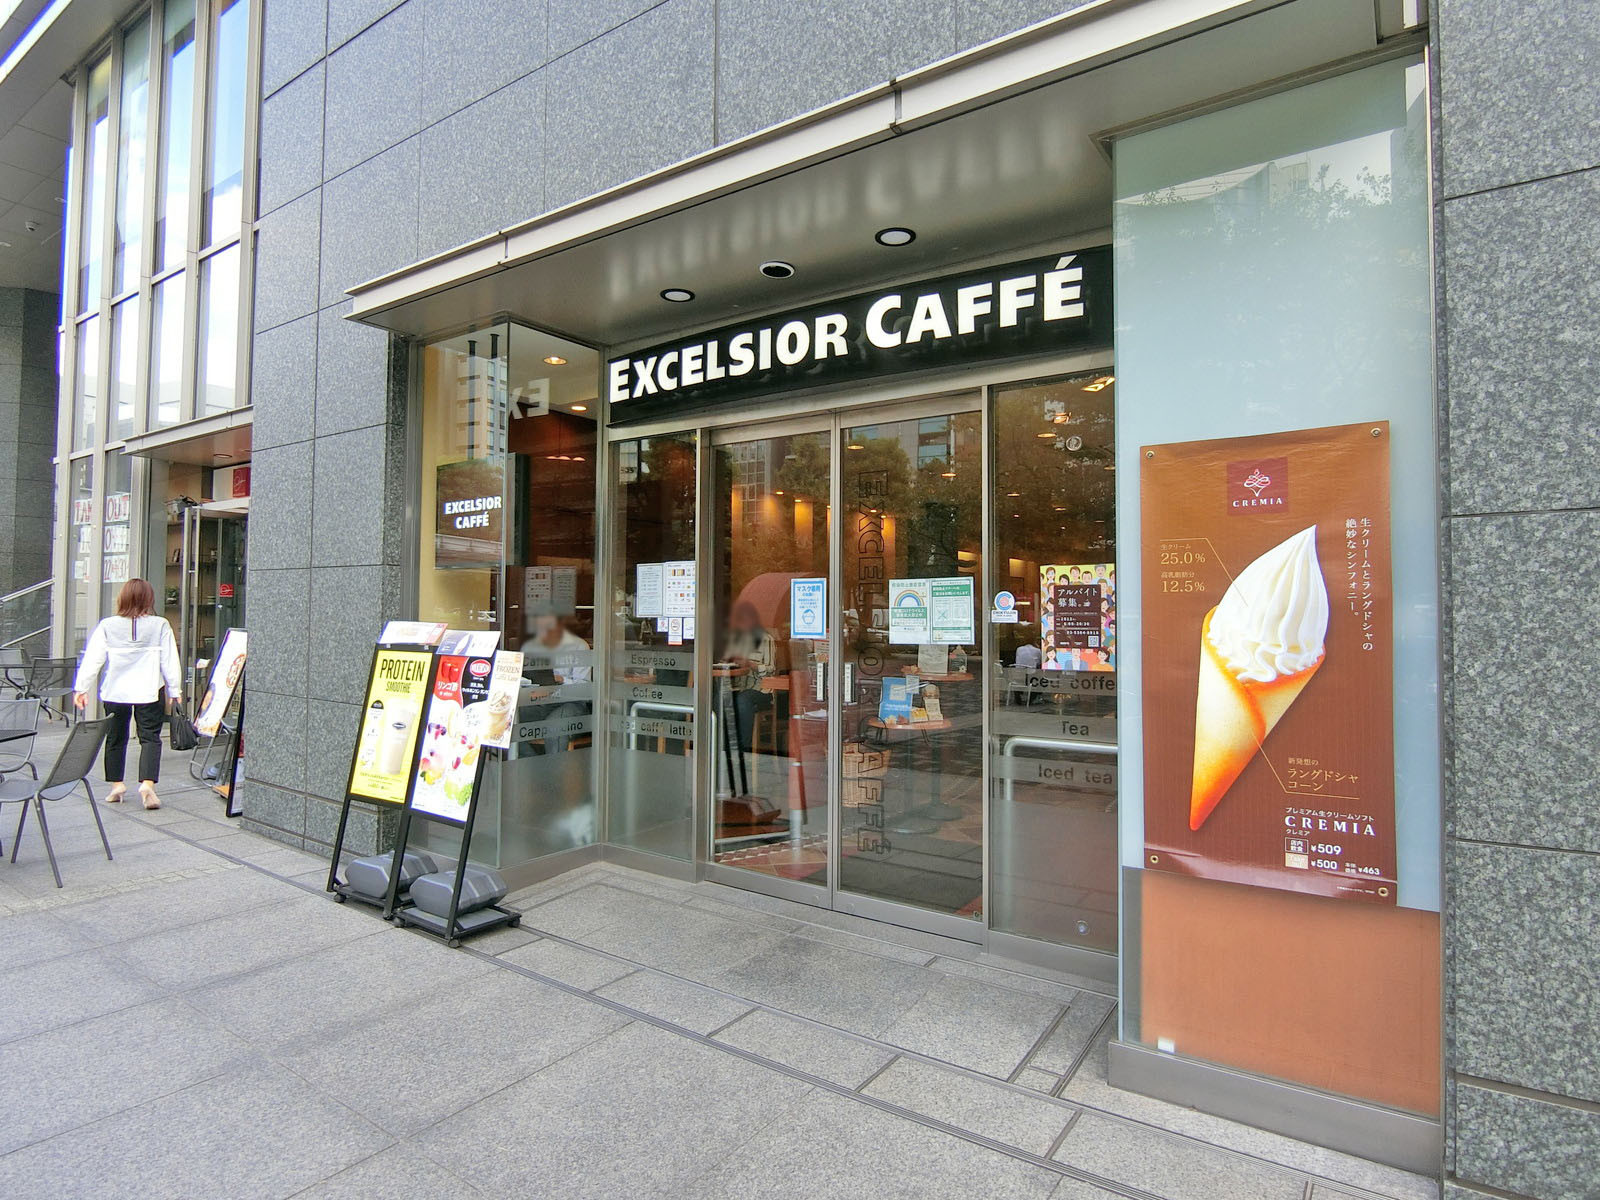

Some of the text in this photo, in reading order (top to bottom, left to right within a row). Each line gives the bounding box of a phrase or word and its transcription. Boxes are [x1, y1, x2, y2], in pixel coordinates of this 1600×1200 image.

[609, 255, 1084, 404] EXCELSIOR CAFFÉ
[445, 496, 502, 515] EXCELSIOR
[1232, 497, 1283, 508] CREMIA
[455, 511, 489, 530] CAFFÉ
[1161, 552, 1206, 565] 25.0%
[1345, 518, 1359, 616] 絶妙なシンフォニー。
[1162, 580, 1205, 593] 12.5%
[1360, 517, 1373, 651] 生クリームとラングドシャの
[1058, 588, 1097, 597] アルバイト
[632, 654, 676, 667] Espresso
[379, 658, 425, 682] PROTEIN
[386, 681, 411, 694] SMOOTHIE
[1025, 673, 1060, 688] Iced
[1062, 721, 1089, 736] Tea
[1039, 764, 1113, 784] Iced tea
[1288, 768, 1359, 783] ラングドシャ
[1288, 781, 1324, 791] コーン
[1285, 807, 1375, 822] プレミアム生クリームソフト
[1284, 815, 1376, 836] CREMIA
[1286, 828, 1311, 836] クレミア
[1310, 843, 1342, 855] ¥509
[1310, 859, 1338, 870] ¥500
[1358, 866, 1380, 876] ¥463
